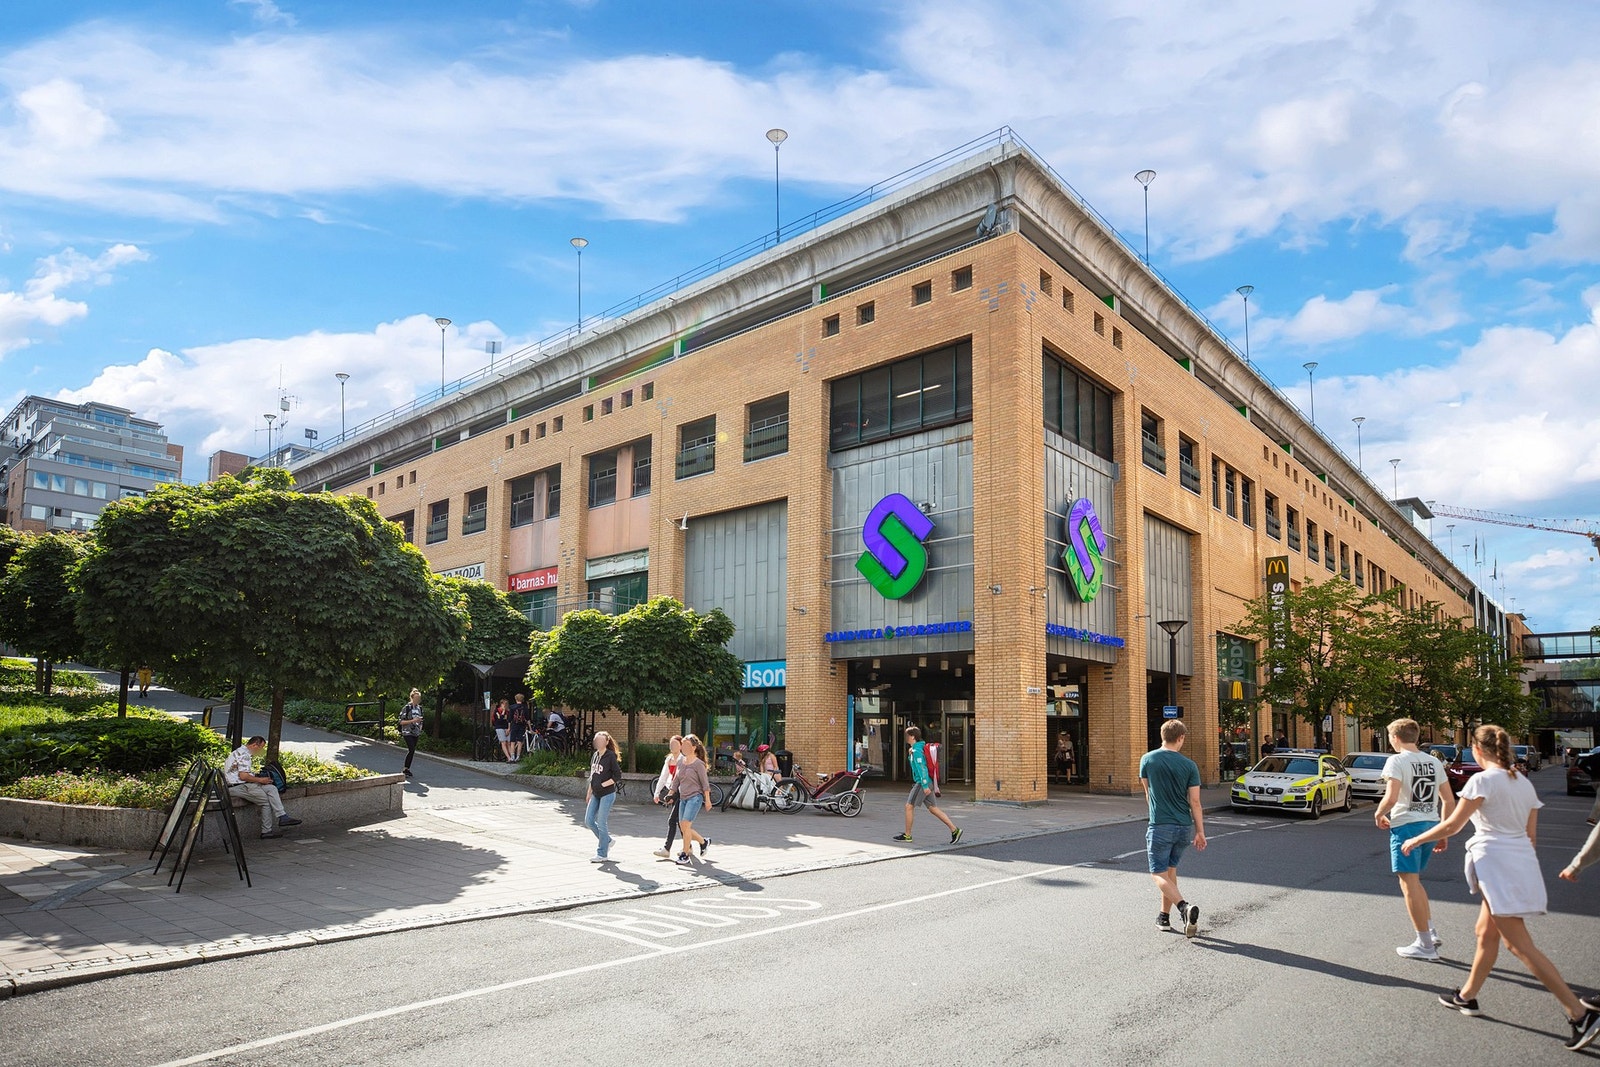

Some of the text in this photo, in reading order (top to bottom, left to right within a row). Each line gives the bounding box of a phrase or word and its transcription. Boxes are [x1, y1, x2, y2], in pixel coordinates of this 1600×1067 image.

[454, 566, 481, 578] MODA
[516, 575, 545, 590] barnas
[825, 620, 973, 643] SANDVIKA STORSENTER
[571, 891, 823, 938] BUSS
